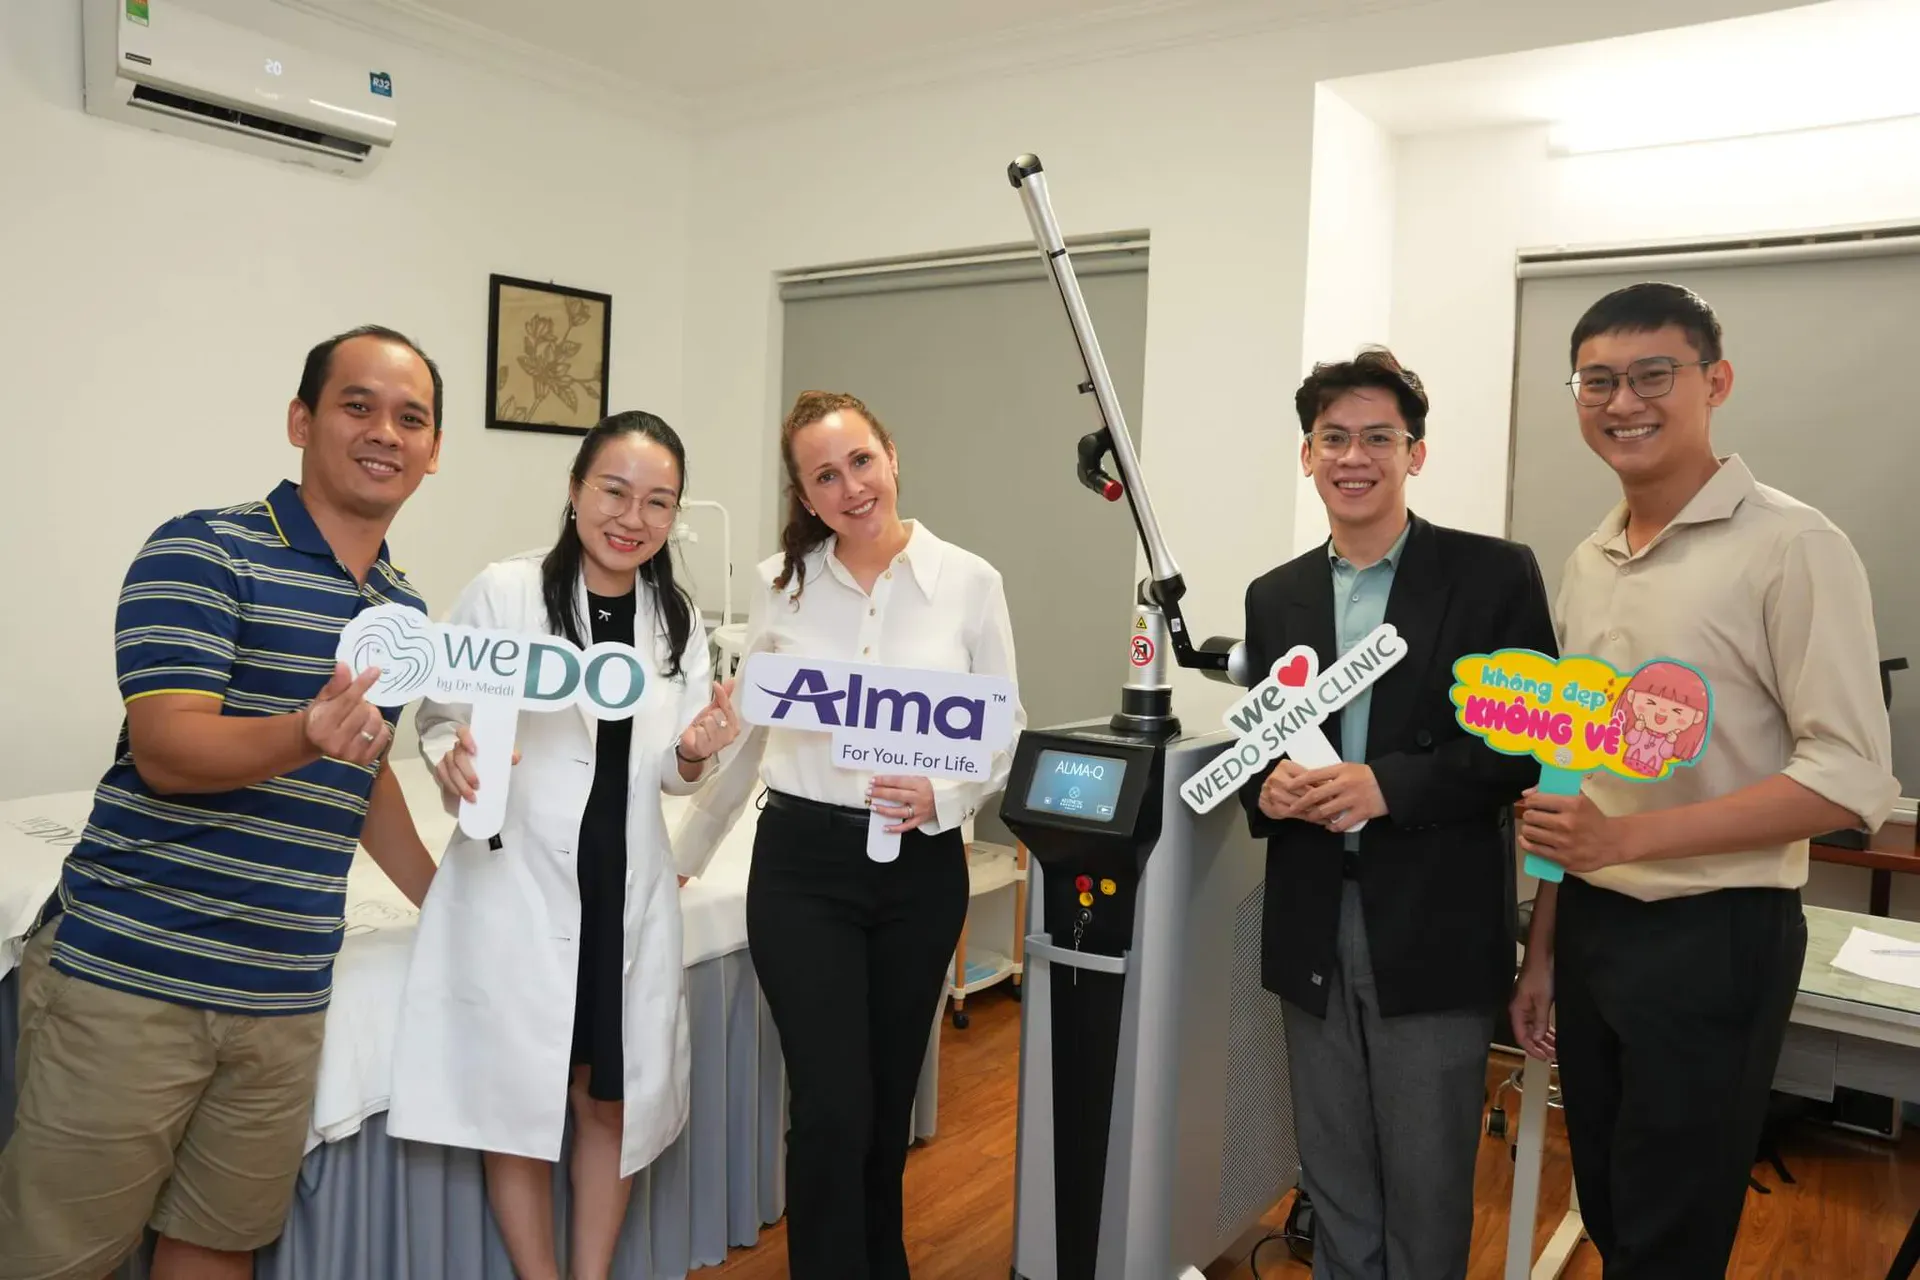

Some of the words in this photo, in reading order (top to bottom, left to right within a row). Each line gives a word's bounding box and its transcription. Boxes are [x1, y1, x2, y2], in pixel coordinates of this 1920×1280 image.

[372, 76, 390, 90] R32
[436, 676, 453, 692] by
[456, 679, 474, 692] Dr.
[477, 682, 515, 697] Meddi
[1562, 682, 1606, 711] đẹp
[756, 668, 986, 741] Alma
[1230, 685, 1285, 734] we
[1188, 744, 1260, 805] WEDO
[1261, 697, 1318, 751] SKIN
[1318, 634, 1397, 704] CLINIC
[1465, 696, 1573, 745] KHÔNG
[842, 744, 870, 762] For
[874, 747, 908, 766] You.
[913, 751, 940, 770] For
[945, 755, 979, 773] Life.
[1055, 760, 1104, 780] ALMA-Q
